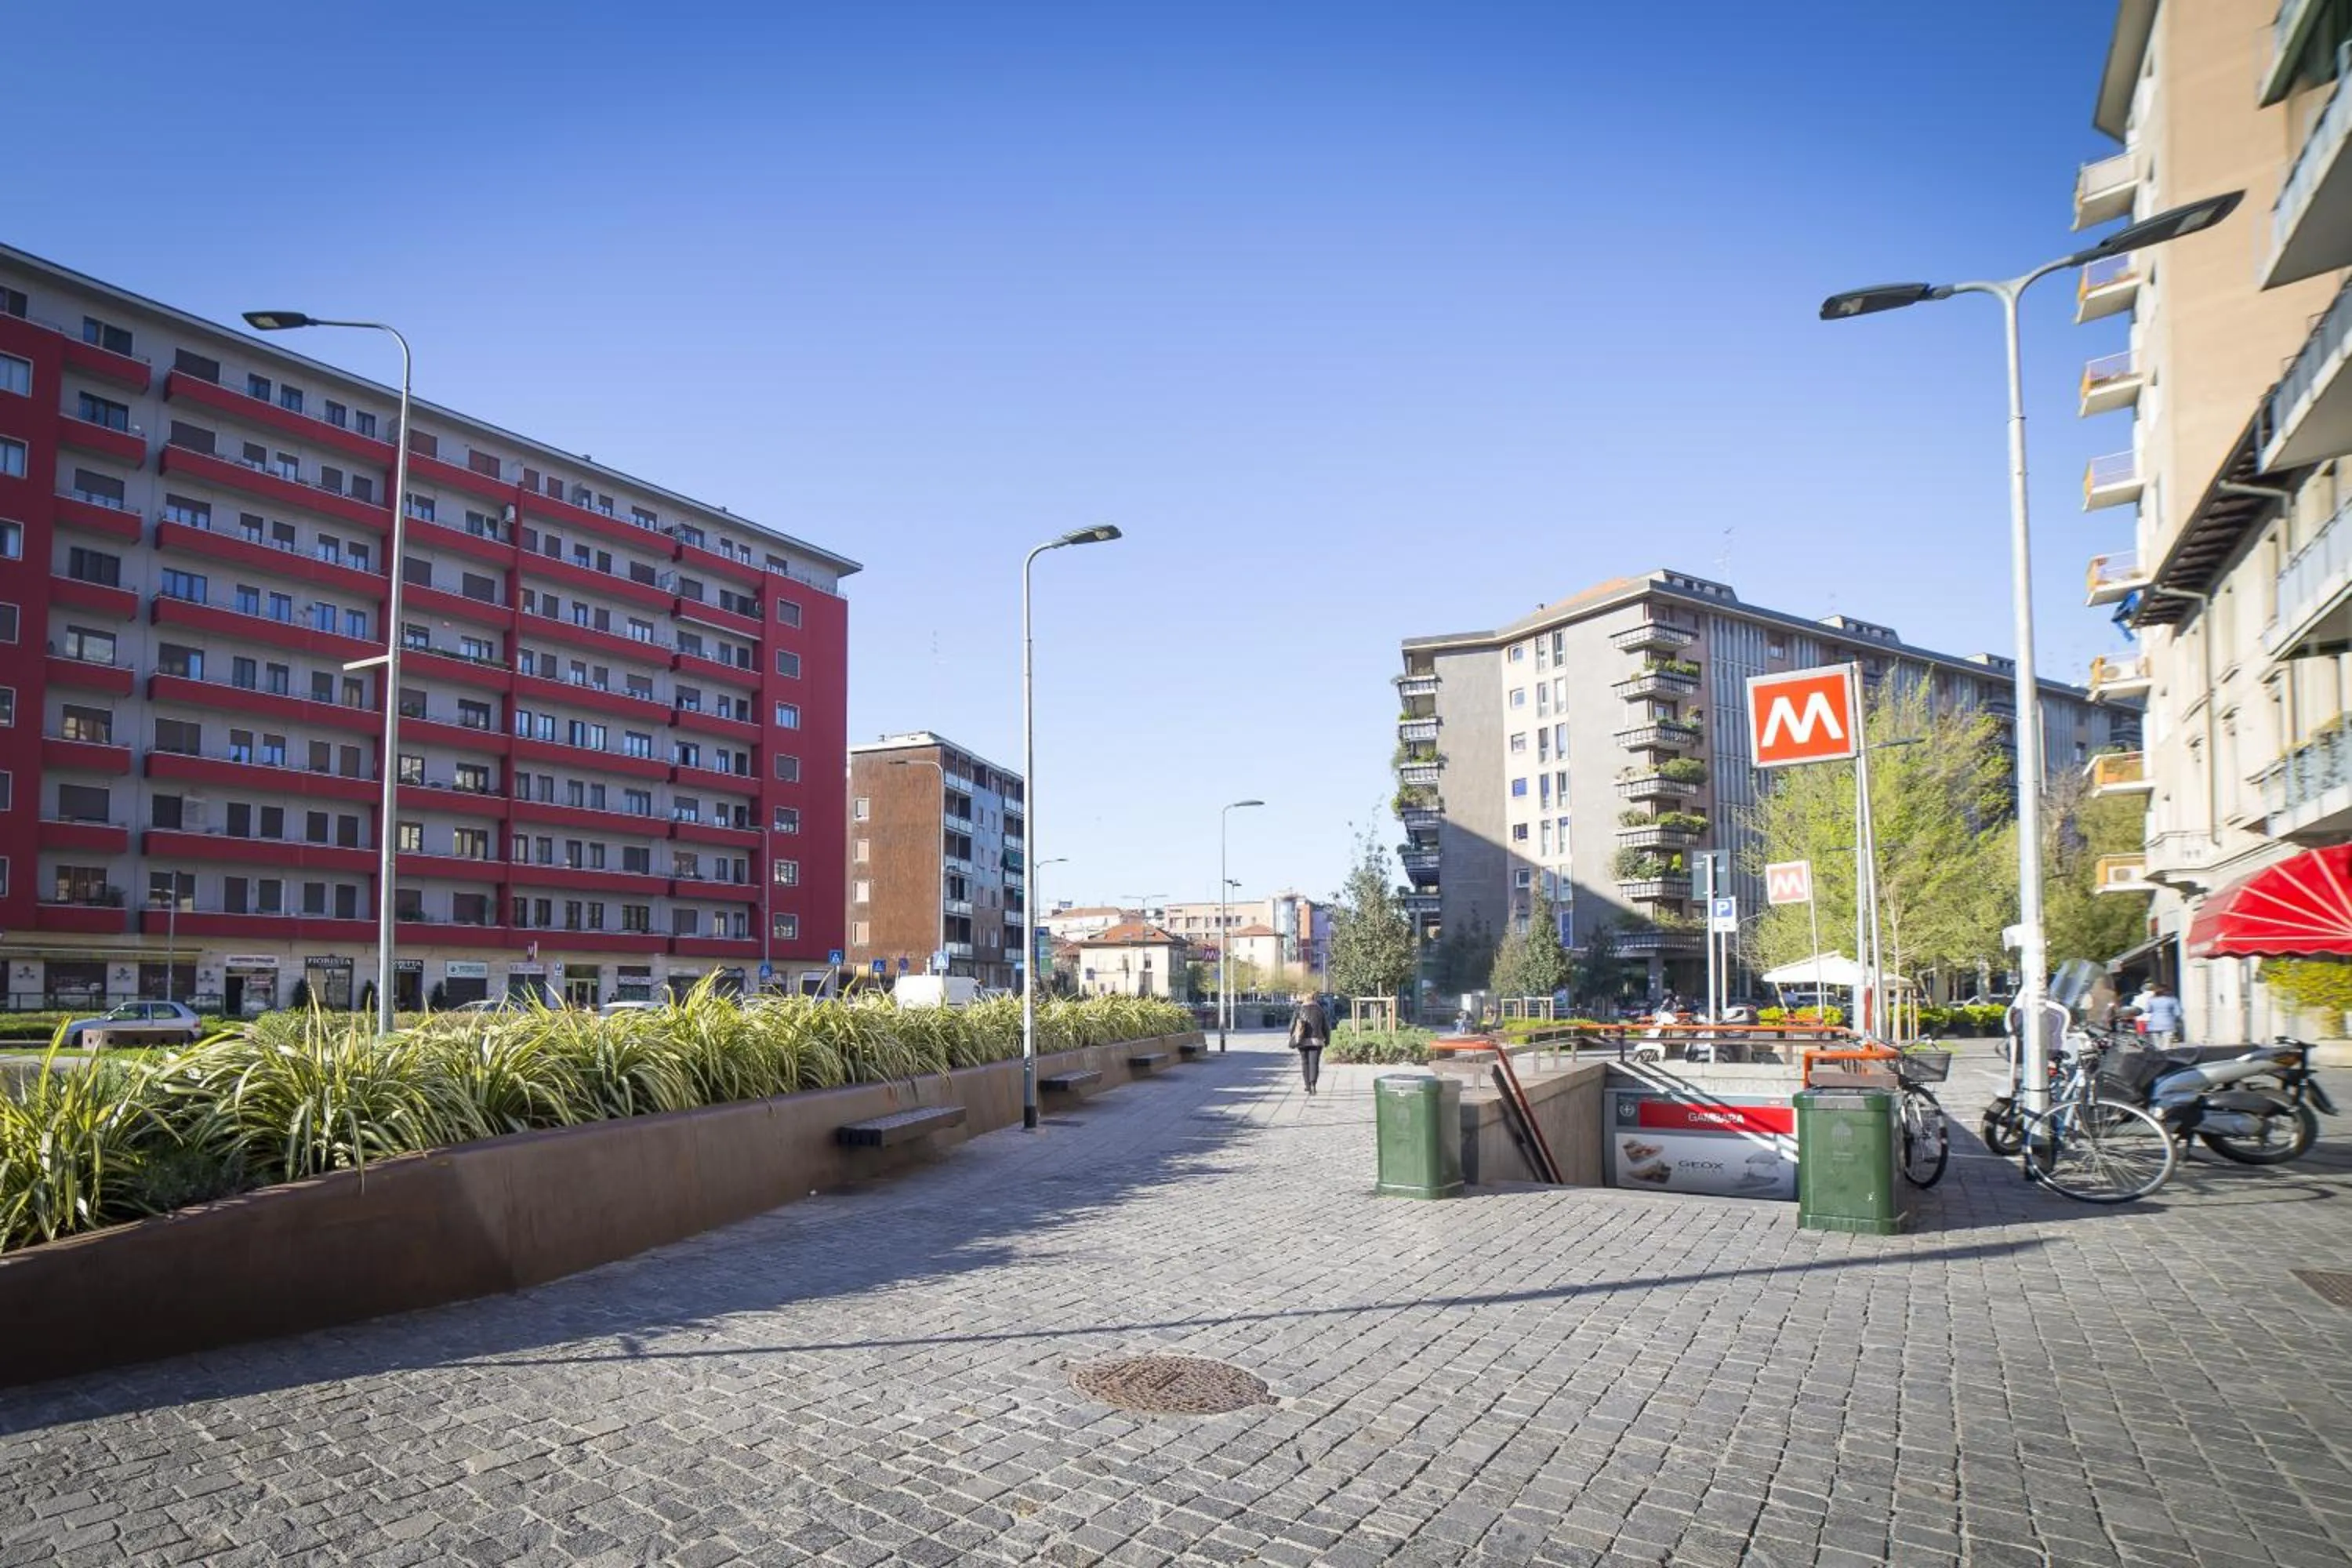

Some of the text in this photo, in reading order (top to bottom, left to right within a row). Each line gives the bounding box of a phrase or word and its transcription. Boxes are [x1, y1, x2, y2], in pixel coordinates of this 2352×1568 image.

[1761, 691, 1845, 747] M
[1771, 871, 1804, 898] M
[1715, 901, 1730, 916] P
[1688, 1112, 1744, 1123] GAMBARA
[1678, 1160, 1725, 1170] GEOX
